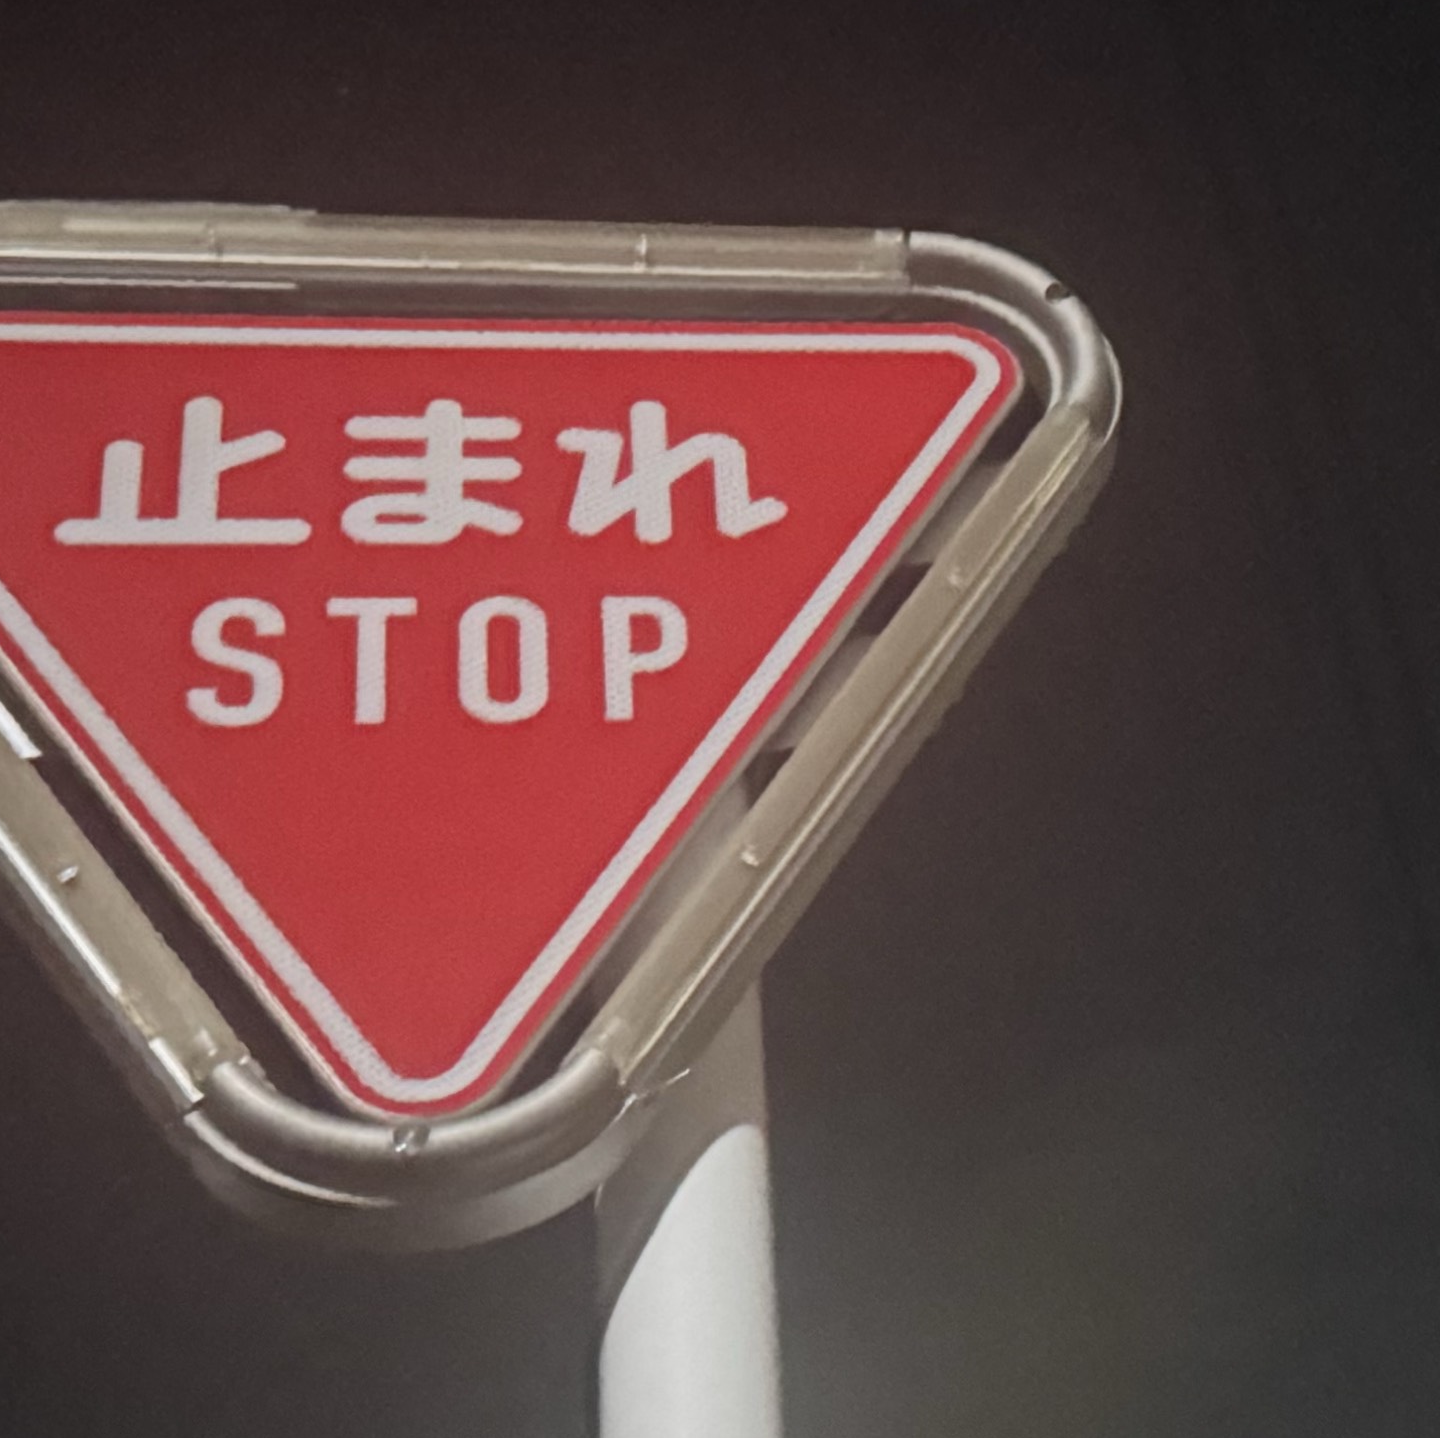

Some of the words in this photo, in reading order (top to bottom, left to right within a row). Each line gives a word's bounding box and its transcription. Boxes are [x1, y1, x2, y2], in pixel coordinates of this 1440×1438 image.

[53, 396, 788, 545] 止まれ
[186, 595, 689, 727] STOP
